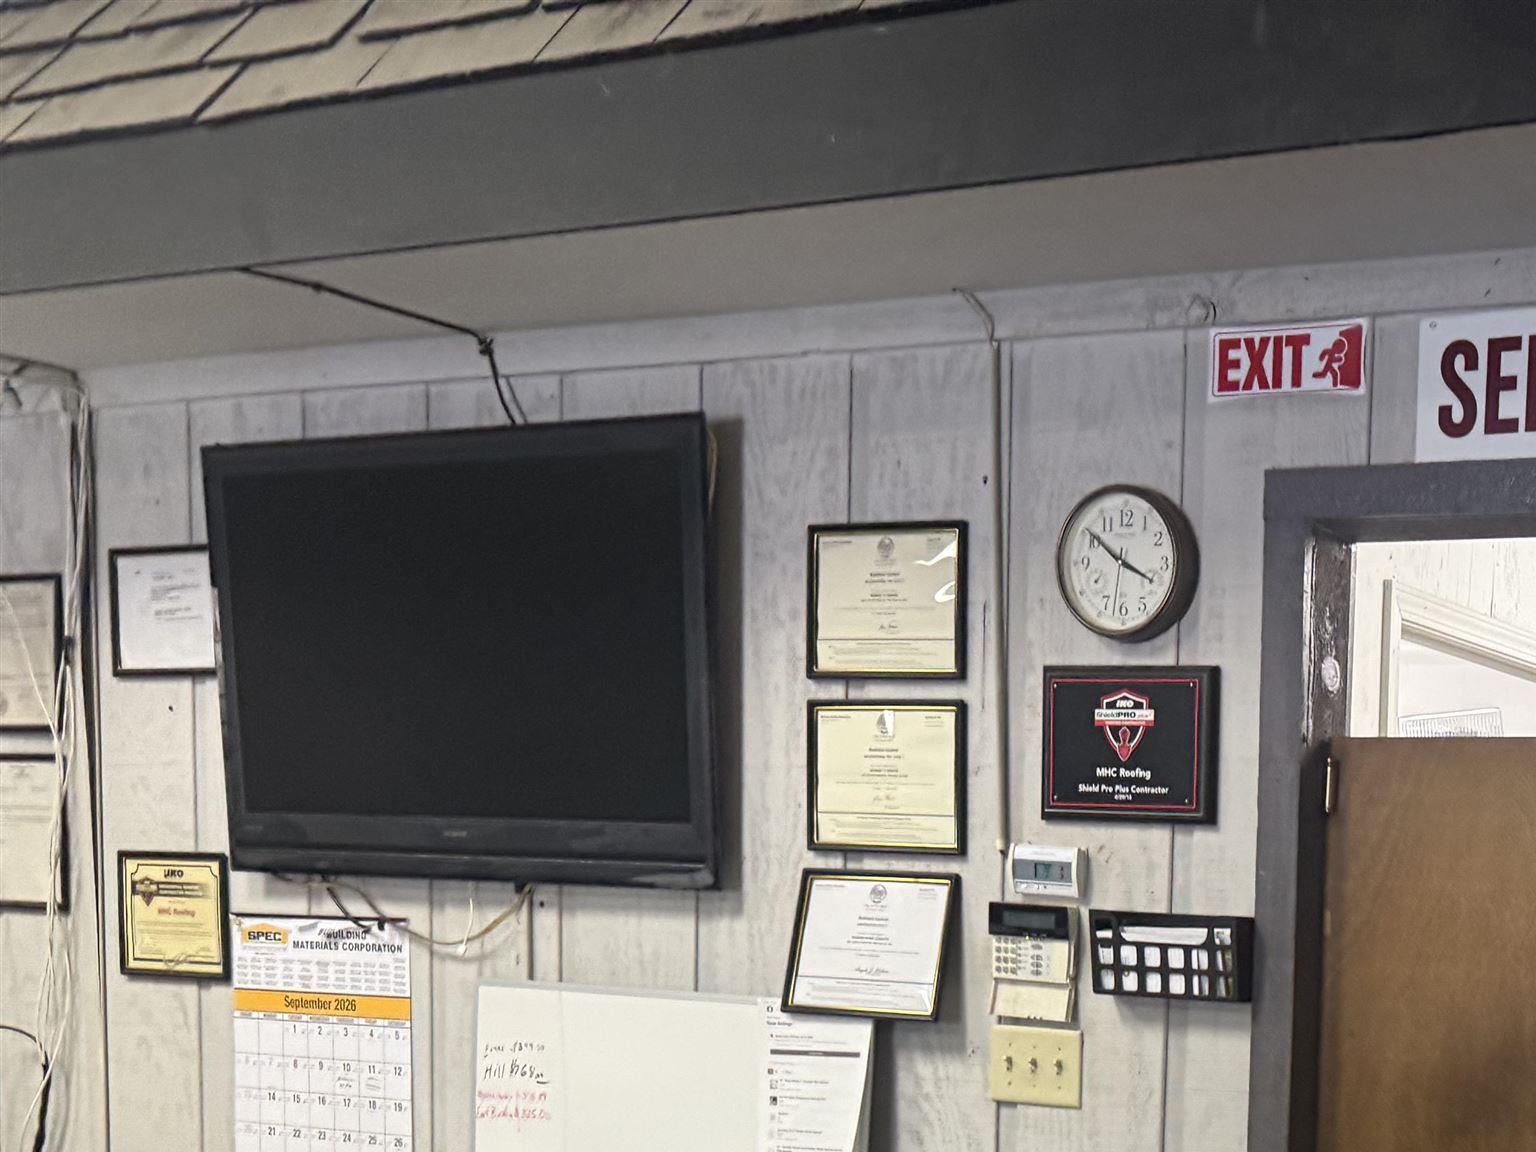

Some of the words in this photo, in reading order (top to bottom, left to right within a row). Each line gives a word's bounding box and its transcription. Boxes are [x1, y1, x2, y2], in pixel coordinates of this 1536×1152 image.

[1217, 333, 1311, 392] EXIT
[1102, 517, 1113, 532] 11
[1120, 509, 1134, 527] 12
[1153, 531, 1163, 546] 2
[1081, 555, 1090, 570] 9
[1160, 556, 1169, 571] 3
[1102, 595, 1110, 611] 7
[1119, 602, 1128, 617] 6
[1138, 596, 1147, 613] 5
[1115, 699, 1135, 709] IKO
[1096, 767, 1117, 778] MHC
[1119, 767, 1152, 780] Roofing
[1078, 783, 1100, 793] Shield
[1101, 784, 1113, 793] Pro
[1114, 784, 1129, 793] Plus
[1130, 784, 1170, 794] Contractor
[247, 930, 282, 942] SPEC
[292, 940, 339, 952] MATERIALS
[342, 942, 403, 954] CORPORATION
[284, 995, 332, 1012] September
[334, 998, 357, 1012] 2026
[343, 1062, 351, 1072] 10
[368, 1065, 376, 1075] 11
[394, 1066, 402, 1076] 12
[268, 1092, 276, 1101] 14
[293, 1094, 301, 1104] 15
[318, 1096, 326, 1105] 16
[343, 1098, 351, 1108] 17
[368, 1100, 377, 1110] 18
[268, 1126, 276, 1136] 21
[293, 1129, 302, 1138] 22
[318, 1130, 326, 1140] 23
[343, 1133, 351, 1143] 24
[368, 1135, 377, 1145] 25
[394, 1138, 403, 1148] 26
